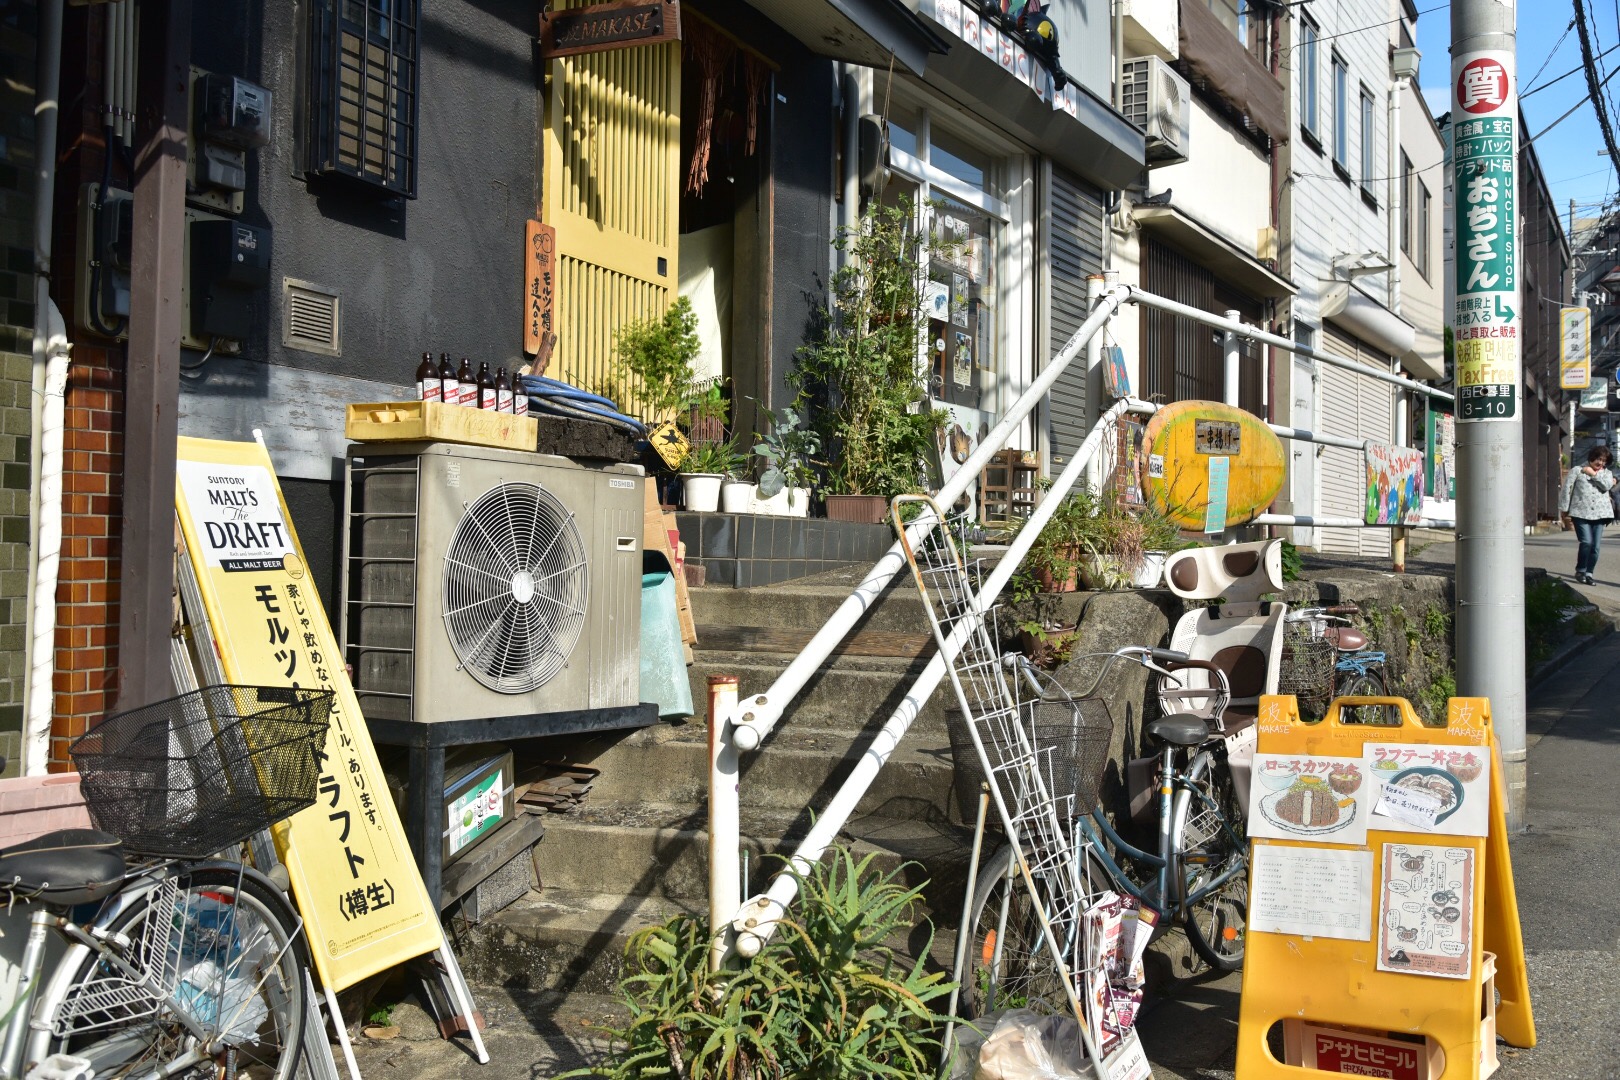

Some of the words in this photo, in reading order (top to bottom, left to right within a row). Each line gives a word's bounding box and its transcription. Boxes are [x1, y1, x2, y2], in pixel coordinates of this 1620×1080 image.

[581, 11, 652, 40] MAKASE
[1463, 65, 1503, 108] 質
[1456, 120, 1511, 140] 貴金属・宝石
[1504, 177, 1512, 235] UNCLE
[1466, 175, 1500, 291] おぢさん
[1505, 241, 1513, 288] SHOP
[541, 271, 552, 334] モルツ樽
[1464, 402, 1506, 416] 3-10
[610, 480, 634, 488] TOSHIBA
[207, 488, 259, 507] MALT'S
[223, 504, 254, 521] The
[204, 521, 285, 549] DRAFT
[243, 561, 261, 569] MALT
[262, 560, 282, 568] BEER
[1261, 701, 1285, 724] 波
[1451, 701, 1475, 730] 波
[1258, 724, 1290, 735] MAKASE
[1446, 726, 1484, 740] MAKASE
[1316, 1037, 1416, 1070] アサヒビール
